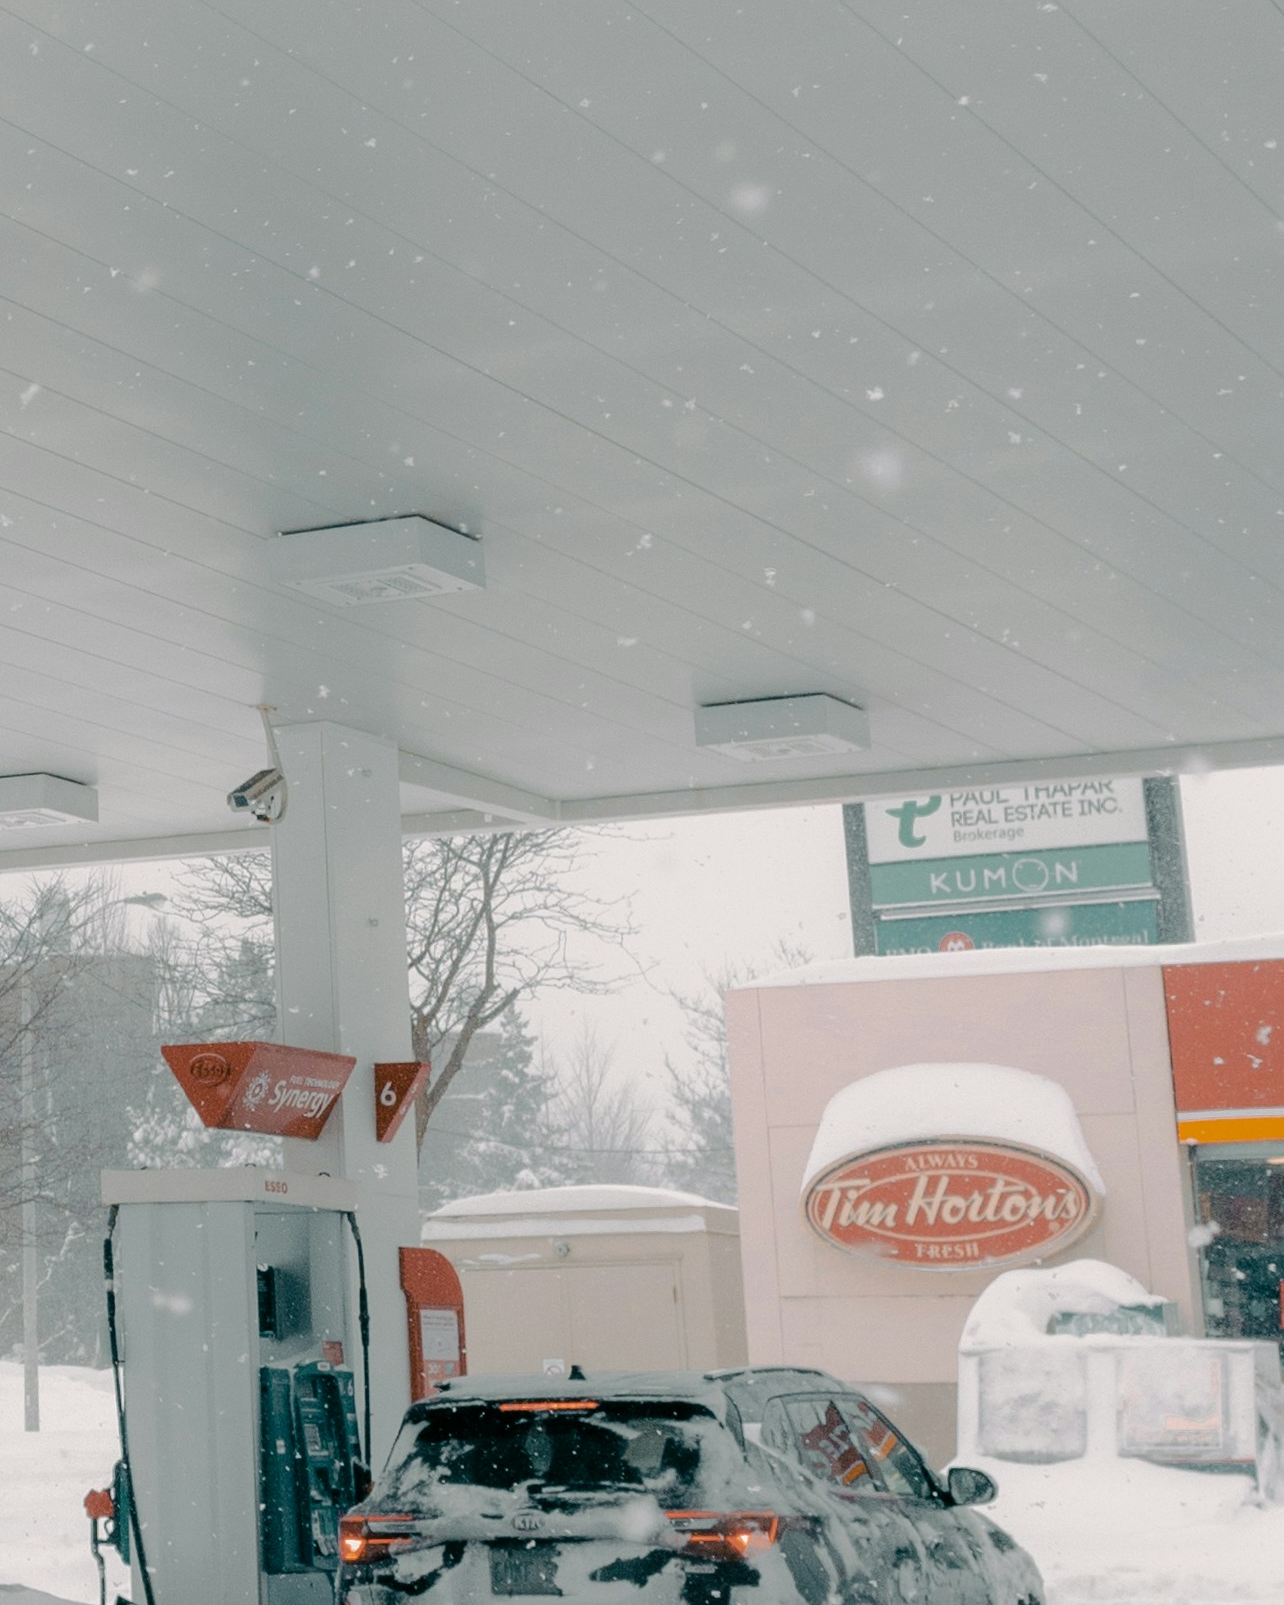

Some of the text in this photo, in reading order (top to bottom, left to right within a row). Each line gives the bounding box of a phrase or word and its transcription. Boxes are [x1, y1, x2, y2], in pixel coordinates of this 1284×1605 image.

[949, 788, 1009, 809] PAUL
[951, 796, 1123, 828] REAL ESTATE INC.
[953, 827, 1025, 843] Brokerage
[929, 858, 1079, 893] KUMON
[268, 1080, 333, 1119] Synergy
[380, 1081, 397, 1107] 6
[904, 1152, 979, 1172] ALWAYS
[264, 1180, 288, 1195] ESSO
[815, 1174, 1080, 1231] Tim Hortons
[915, 1242, 980, 1259] FRESH
